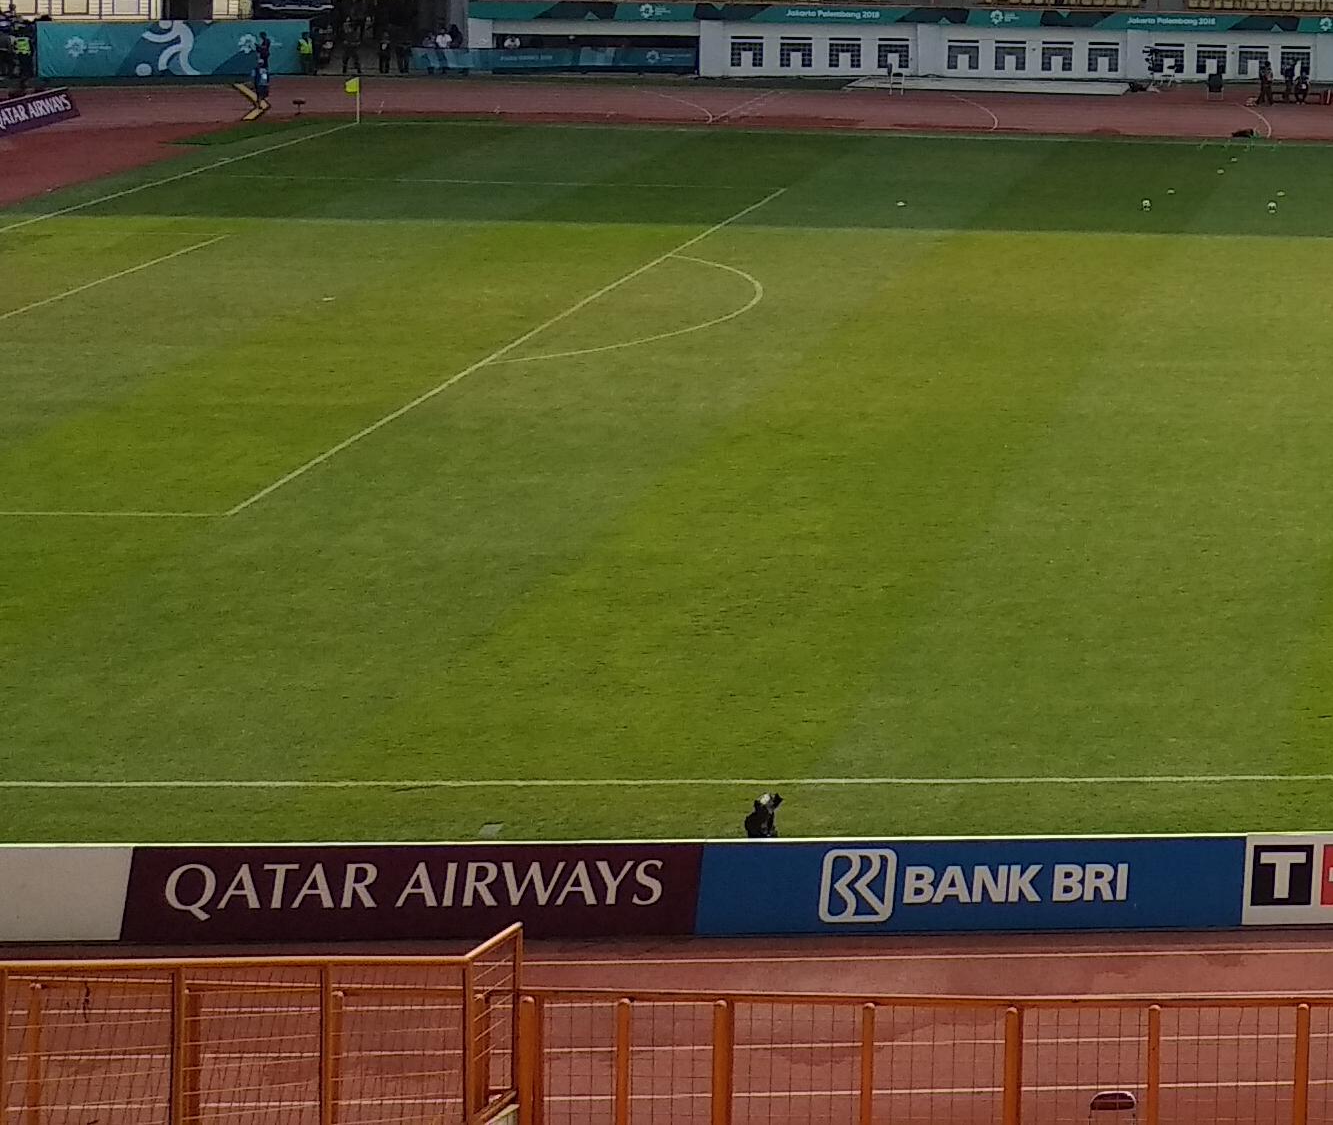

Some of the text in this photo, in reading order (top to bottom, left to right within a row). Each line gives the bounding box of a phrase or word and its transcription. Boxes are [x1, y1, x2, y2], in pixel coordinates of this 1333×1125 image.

[29, 93, 72, 118] AIRWAYS
[164, 859, 664, 921] QATAR AIRWAYS
[902, 863, 1042, 904] BANK
[1052, 862, 1130, 902] BRI
